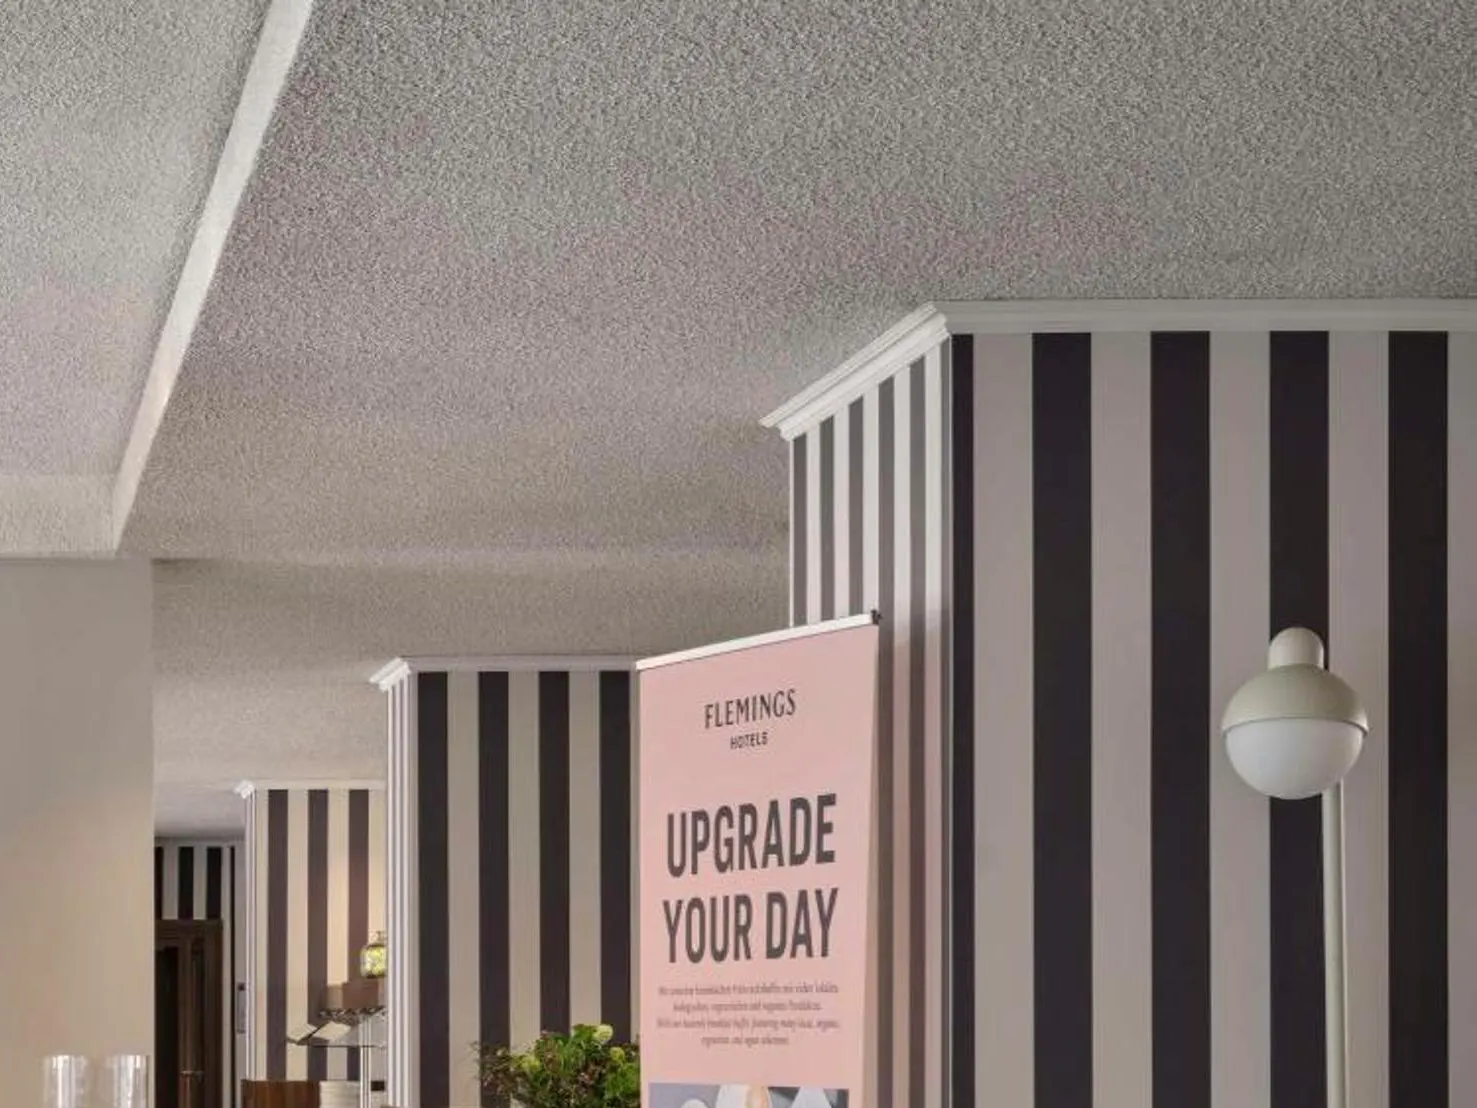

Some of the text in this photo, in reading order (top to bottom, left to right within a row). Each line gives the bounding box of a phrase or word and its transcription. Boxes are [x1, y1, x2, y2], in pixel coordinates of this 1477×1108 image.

[704, 688, 797, 729] FLEMINGS
[729, 731, 769, 749] HOTELS
[666, 793, 838, 878] UPGRADE
[662, 887, 839, 964] YOUR DAY
